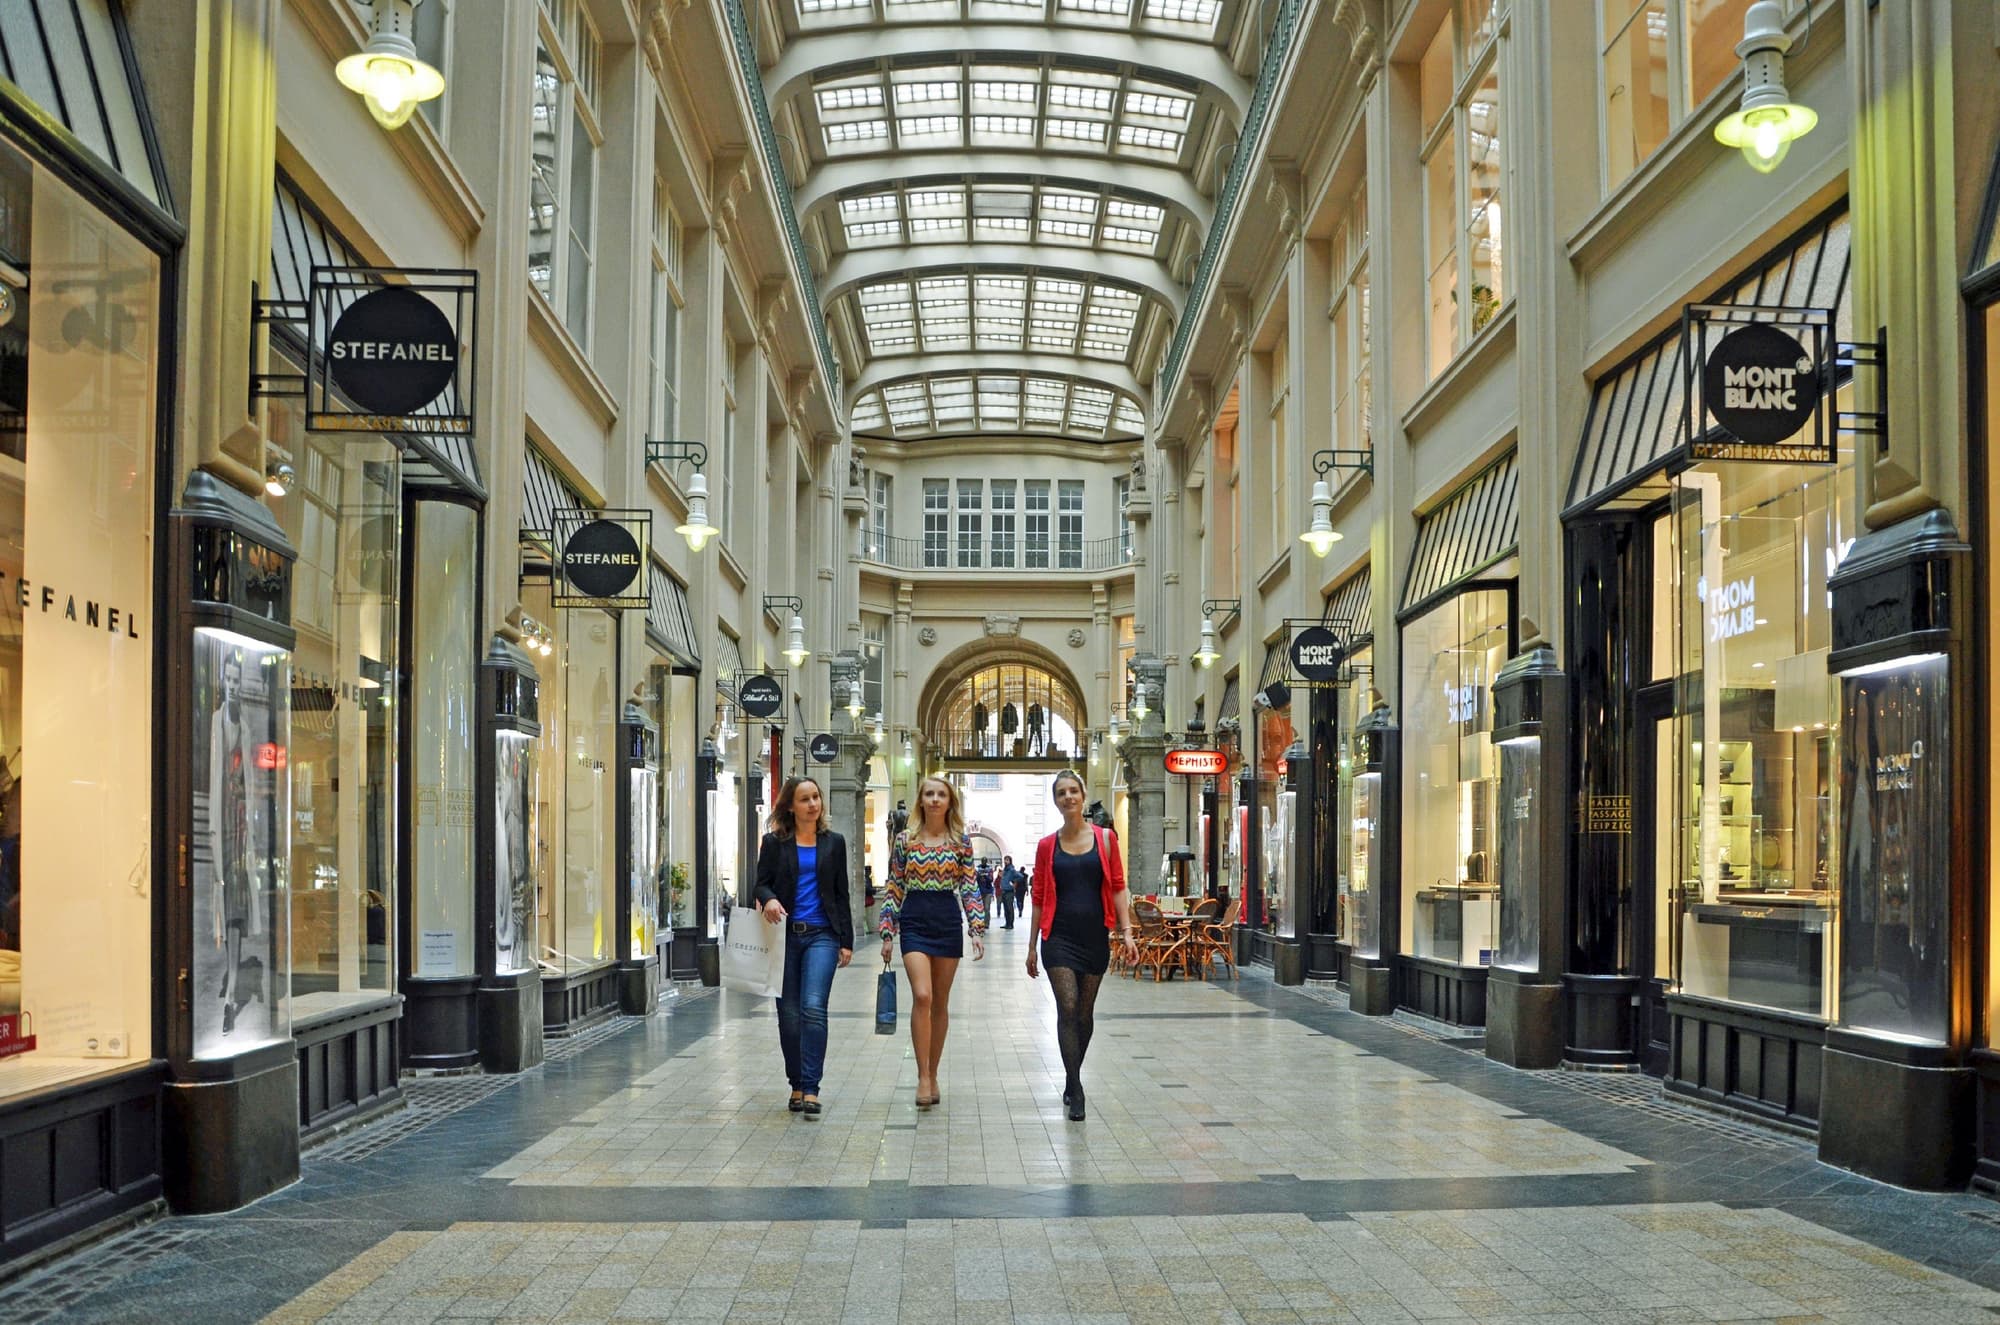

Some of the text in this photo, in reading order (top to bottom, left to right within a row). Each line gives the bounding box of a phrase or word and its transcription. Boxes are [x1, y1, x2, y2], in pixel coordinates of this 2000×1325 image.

[332, 341, 453, 361] STEFANEL
[1724, 365, 1796, 388] MONT
[1724, 388, 1796, 411] BLANC
[566, 553, 639, 565] STEFANEL
[0, 571, 138, 638] EFANEL
[1299, 645, 1333, 656] MONT
[1299, 655, 1333, 666] BLANC
[1170, 756, 1223, 768] MEPHISTO
[1876, 753, 1912, 772] MONT
